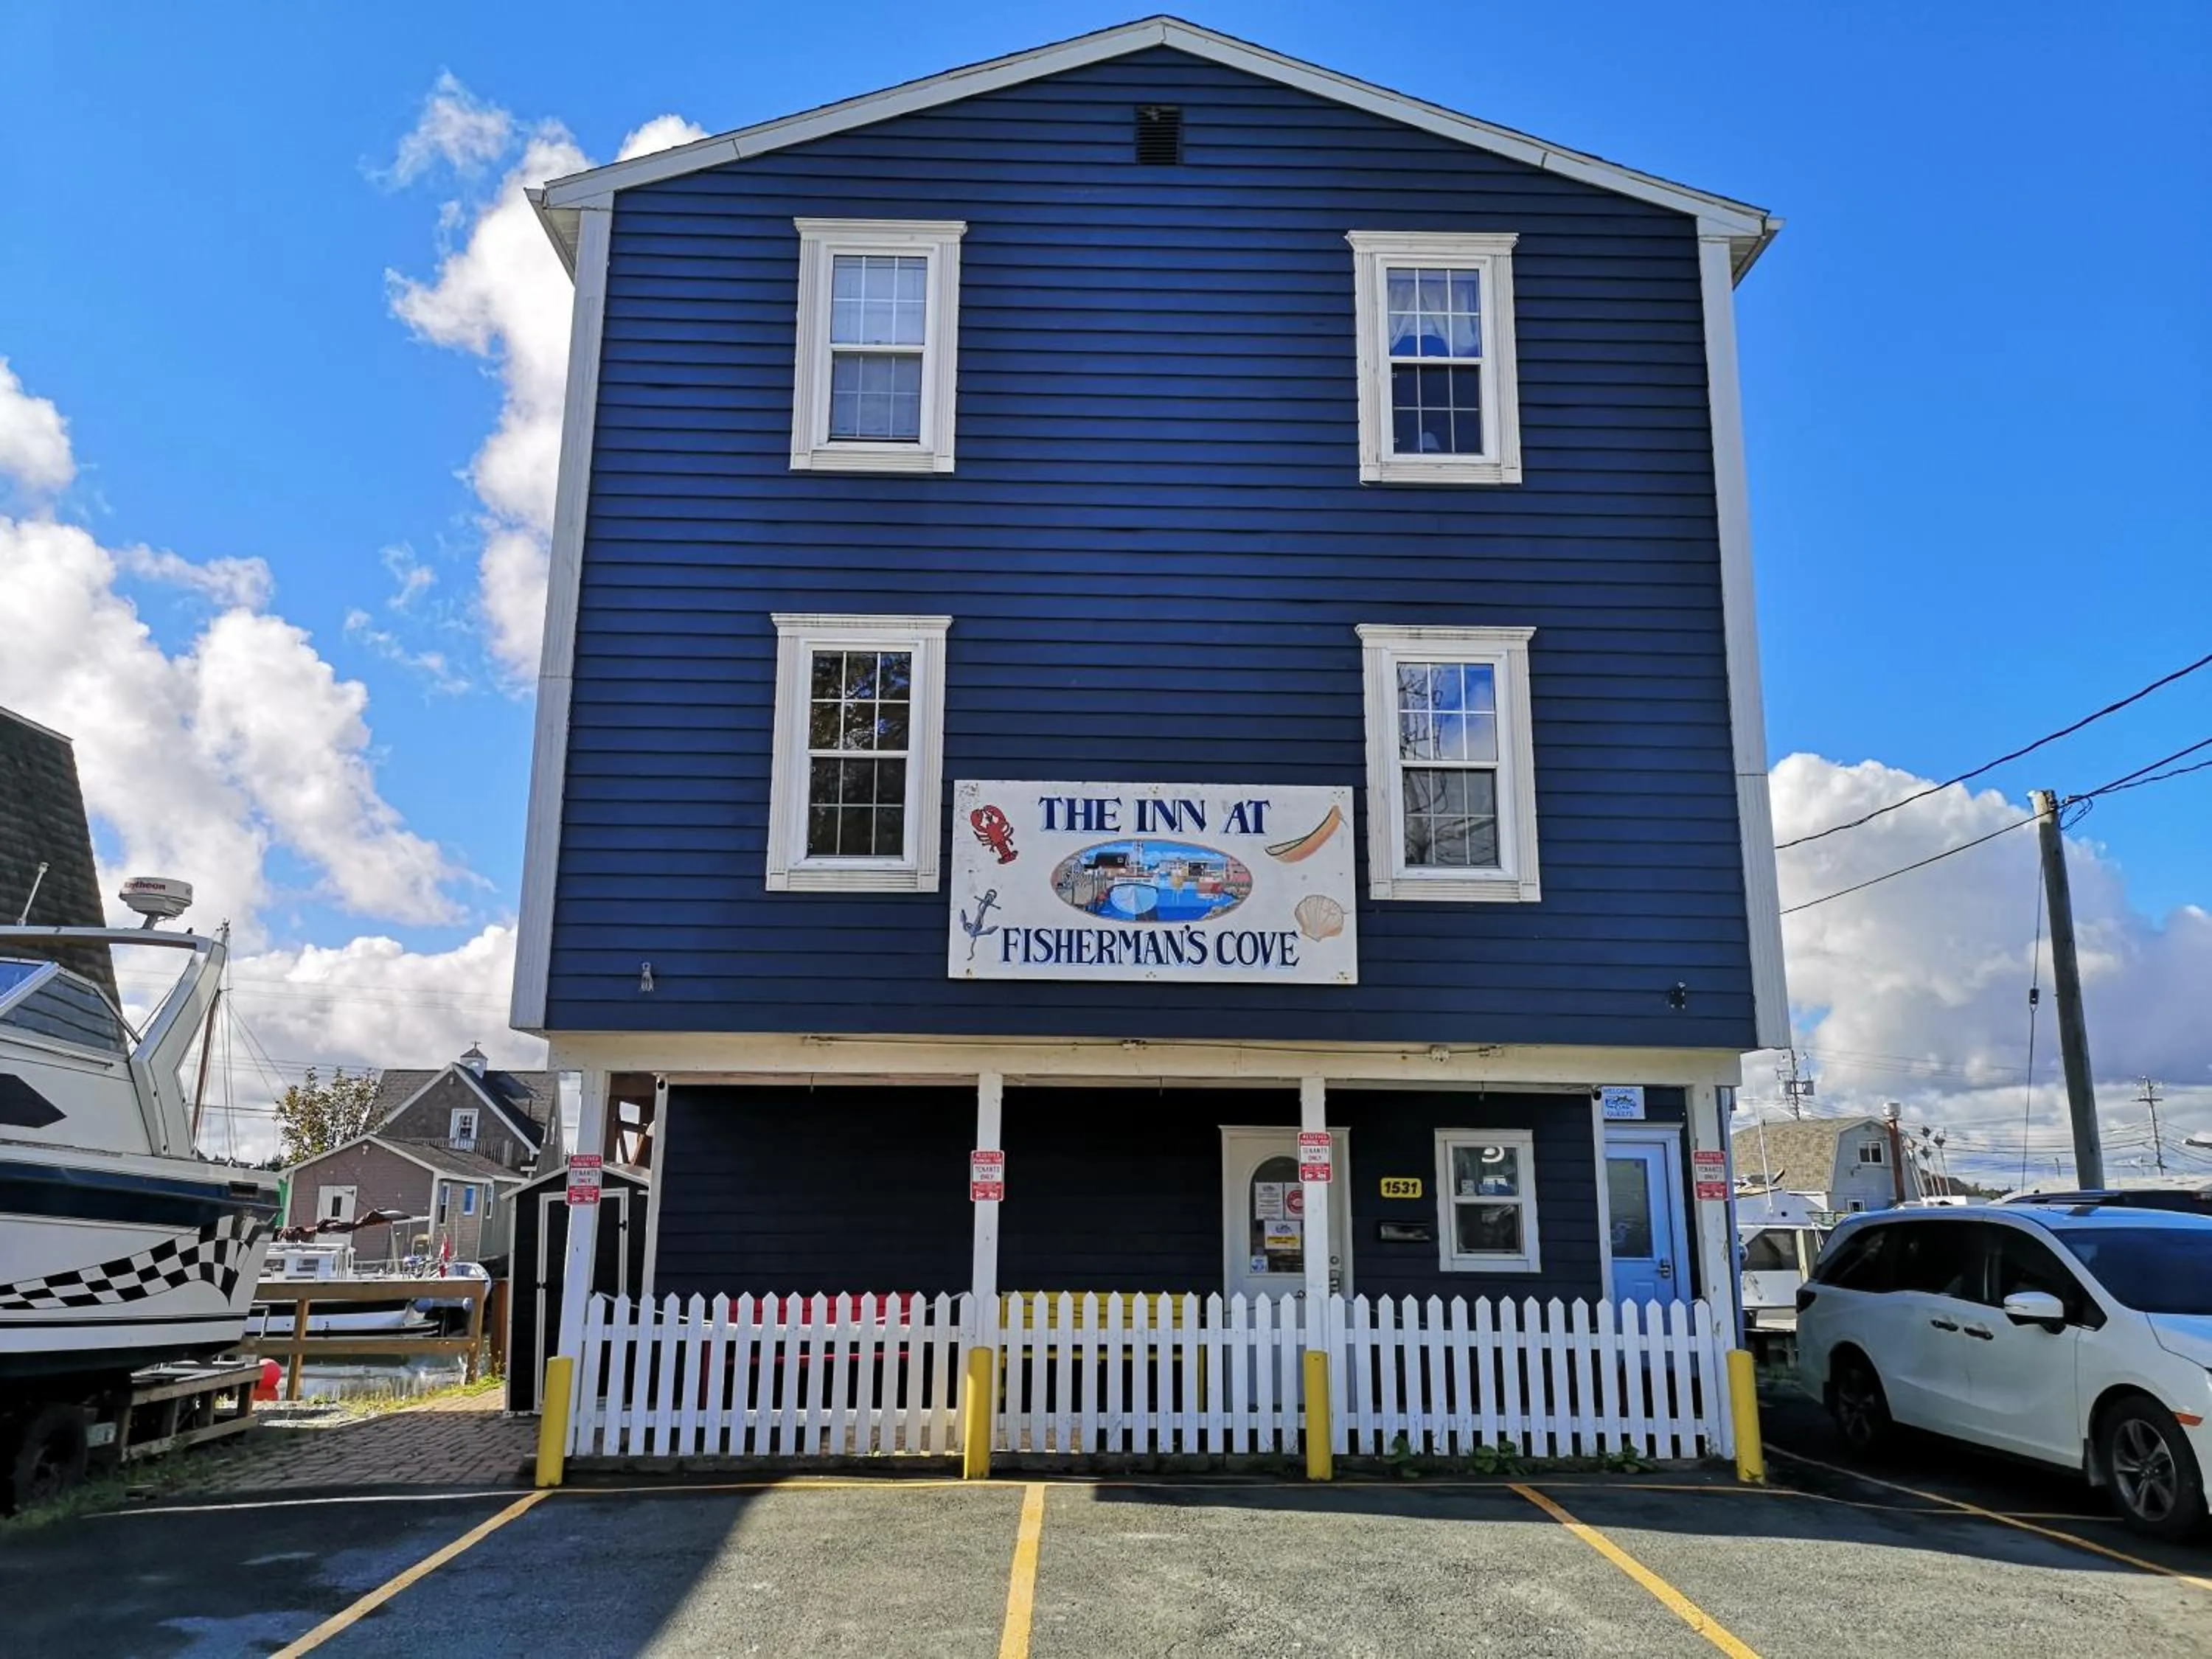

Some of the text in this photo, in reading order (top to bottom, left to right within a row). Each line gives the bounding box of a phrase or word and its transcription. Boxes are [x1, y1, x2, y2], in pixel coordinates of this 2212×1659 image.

[1038, 796, 1272, 835] THE INN AT
[124, 879, 166, 891] aytheon
[1001, 925, 1300, 967] FISHERMAN'S COVE
[1385, 1181, 1417, 1194] 1531
